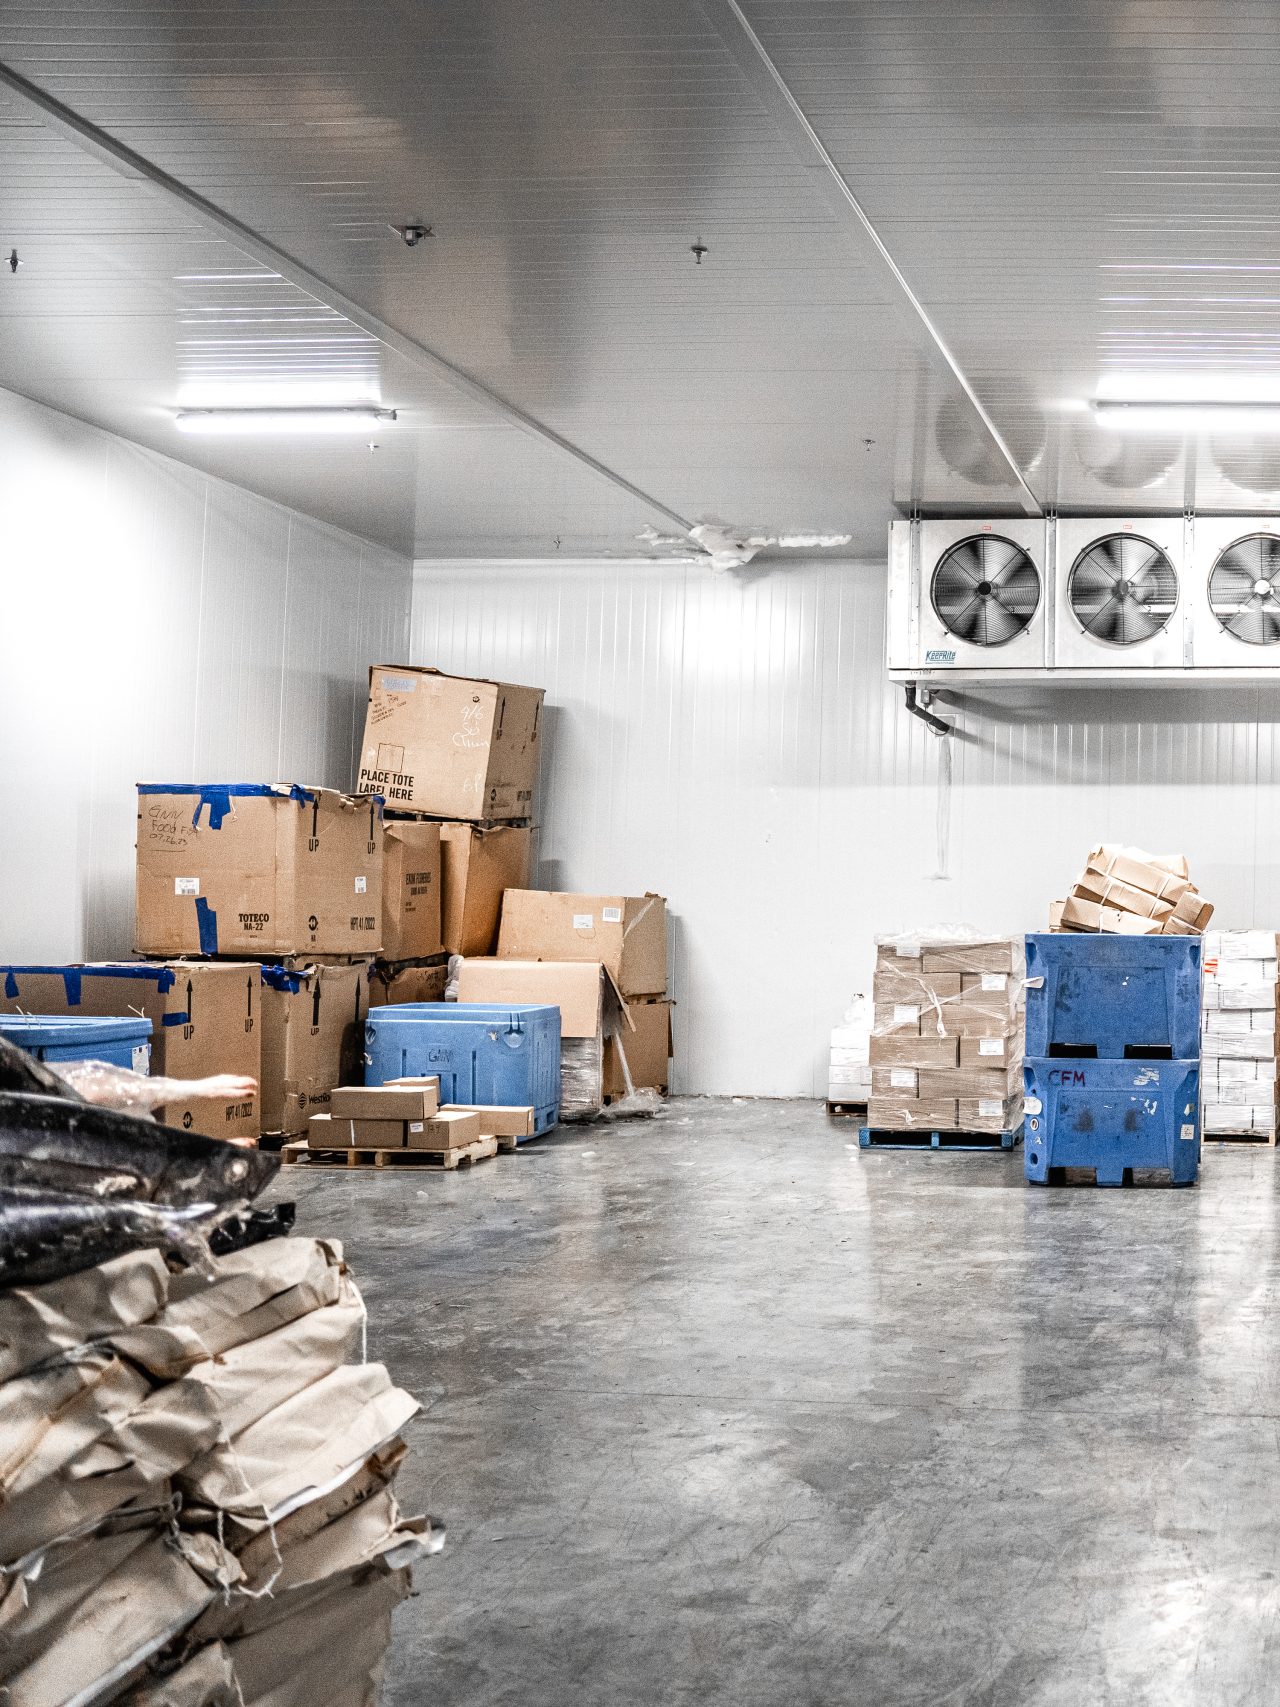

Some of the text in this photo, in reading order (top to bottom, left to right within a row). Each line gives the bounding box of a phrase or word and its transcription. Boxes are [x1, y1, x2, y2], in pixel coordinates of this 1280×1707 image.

[361, 769, 414, 787] PLACE TOTE
[389, 787, 413, 800] HERE
[308, 839, 319, 852] UP
[367, 842, 376, 854] UP
[239, 913, 269, 922] TOTECO
[184, 1025, 195, 1040] UP
[1048, 1070, 1086, 1087] CFM
